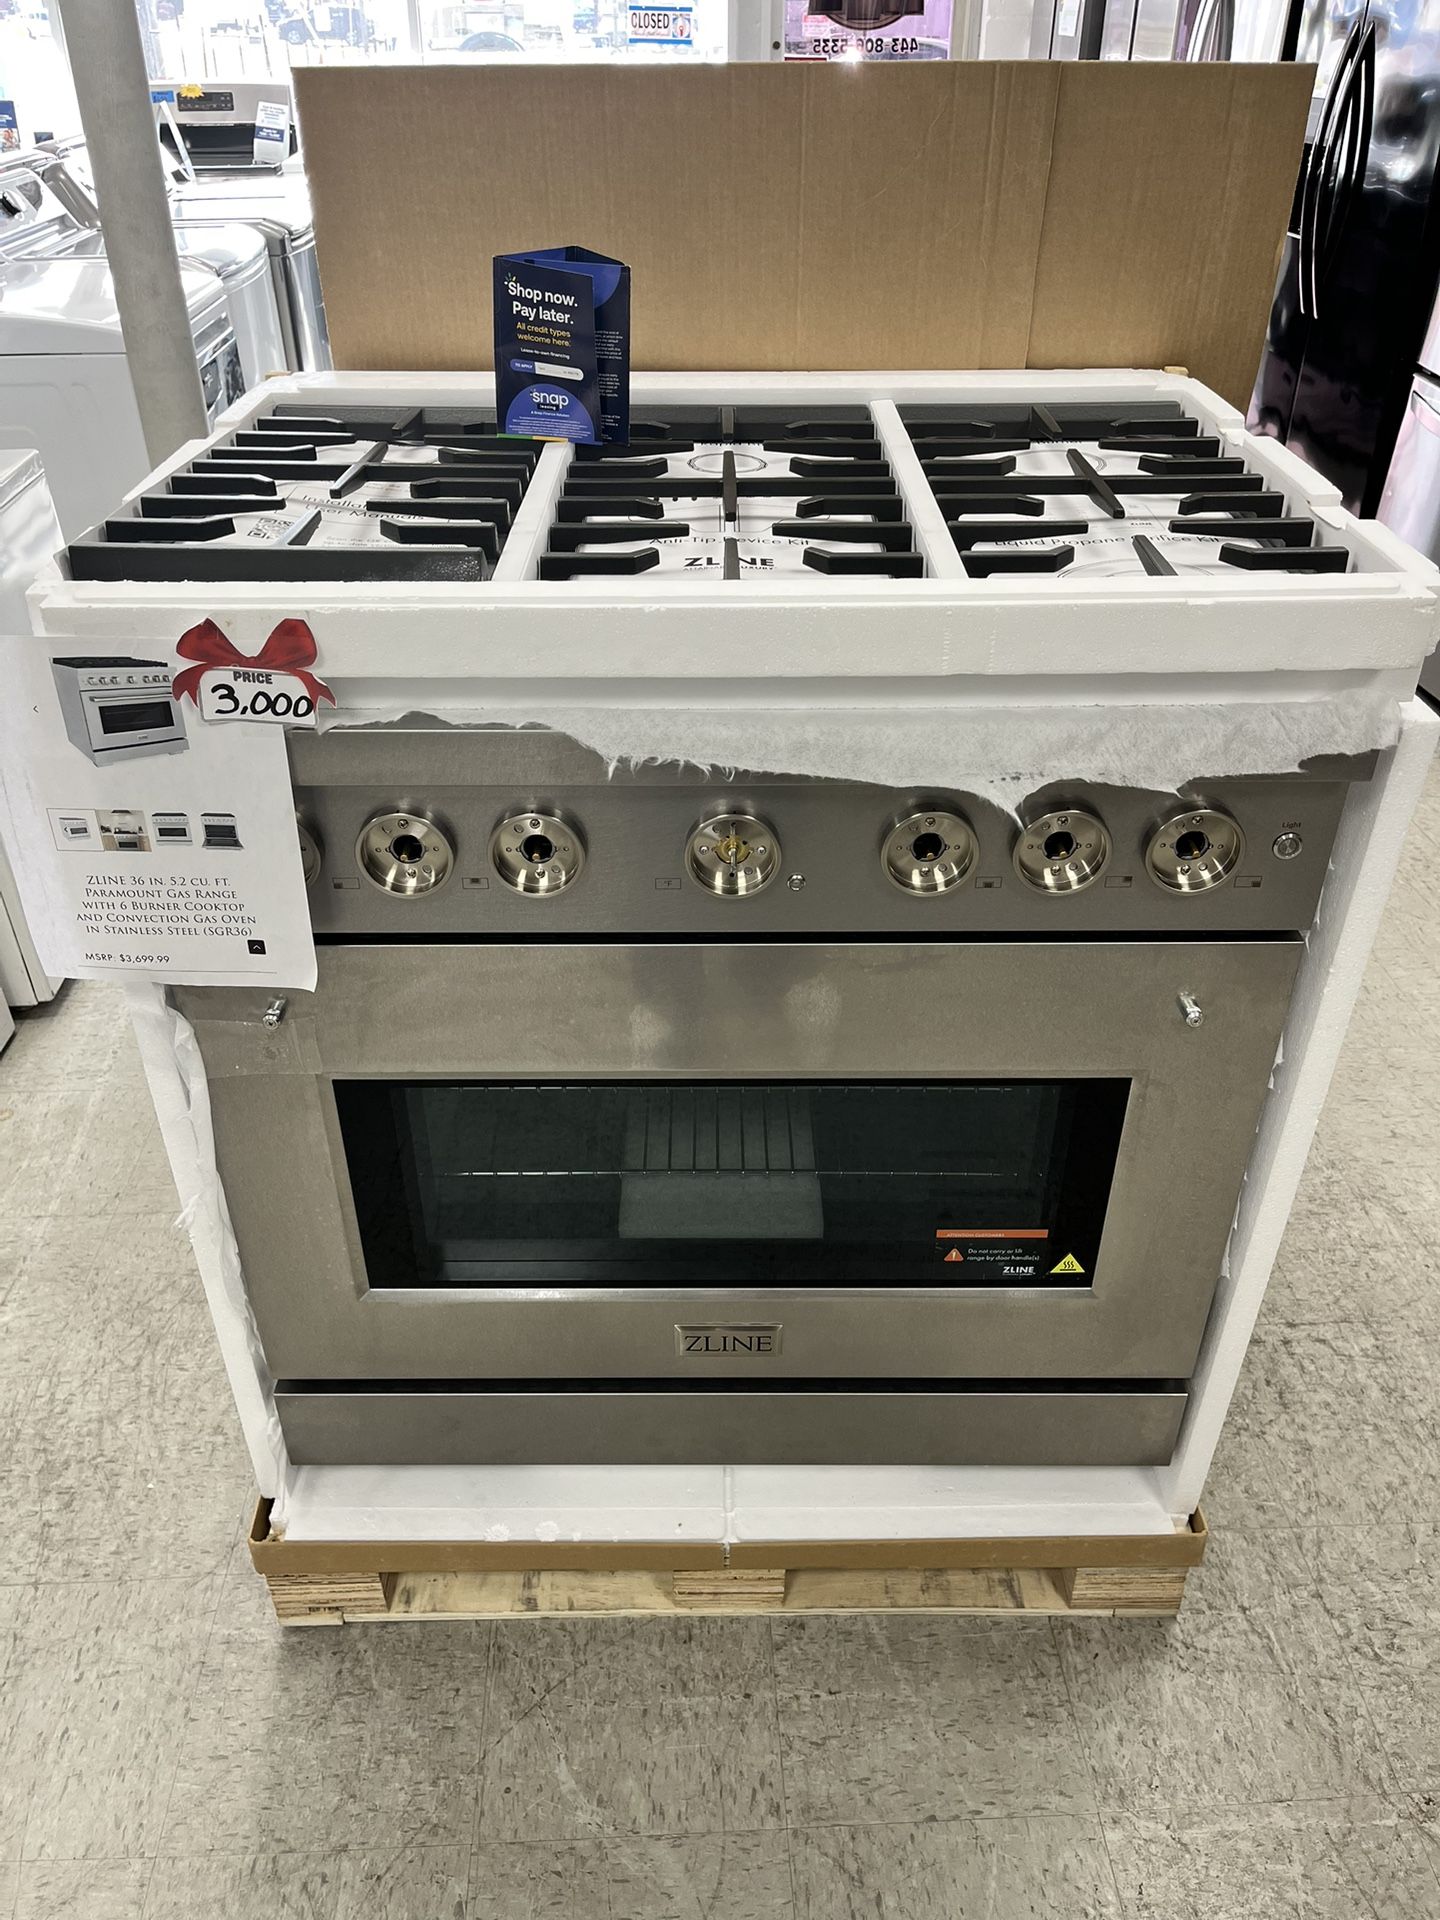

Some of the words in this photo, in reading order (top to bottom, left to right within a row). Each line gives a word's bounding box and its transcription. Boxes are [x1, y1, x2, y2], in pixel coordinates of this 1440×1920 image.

[631, 12, 670, 29] CLOSED
[508, 281, 542, 303] Shop
[545, 291, 578, 307] now.
[512, 301, 537, 321] Pay
[539, 306, 574, 325] later.
[516, 322, 526, 331] All
[527, 324, 549, 334] credit
[550, 328, 571, 338] types
[517, 333, 551, 344] welcome
[552, 338, 571, 347] here.
[532, 391, 569, 410] snap
[349, 509, 426, 521] Manuals
[650, 536, 716, 545] Anti-Tip
[723, 536, 782, 545] evice
[789, 538, 810, 546] Kit
[994, 537, 1046, 548] Liquid
[1052, 536, 1126, 548] Propane
[1131, 533, 1192, 544] rifice
[684, 556, 775, 567] ZLNE
[232, 671, 273, 684] PRICE
[211, 684, 315, 718] 3,000
[1281, 821, 1302, 830] Light
[86, 875, 126, 886] ZLINE
[130, 875, 145, 886] 36
[149, 877, 166, 886] IN.
[170, 876, 187, 886] 5.2
[190, 877, 210, 887] CU.
[215, 877, 231, 887] FT.
[120, 901, 128, 911] 6
[203, 926, 253, 937] (SGR36)
[85, 953, 116, 962] MSRP:
[119, 953, 170, 964] $3,699.99
[1002, 1266, 1035, 1274] ZLINE
[685, 1335, 773, 1352] ZLINE
